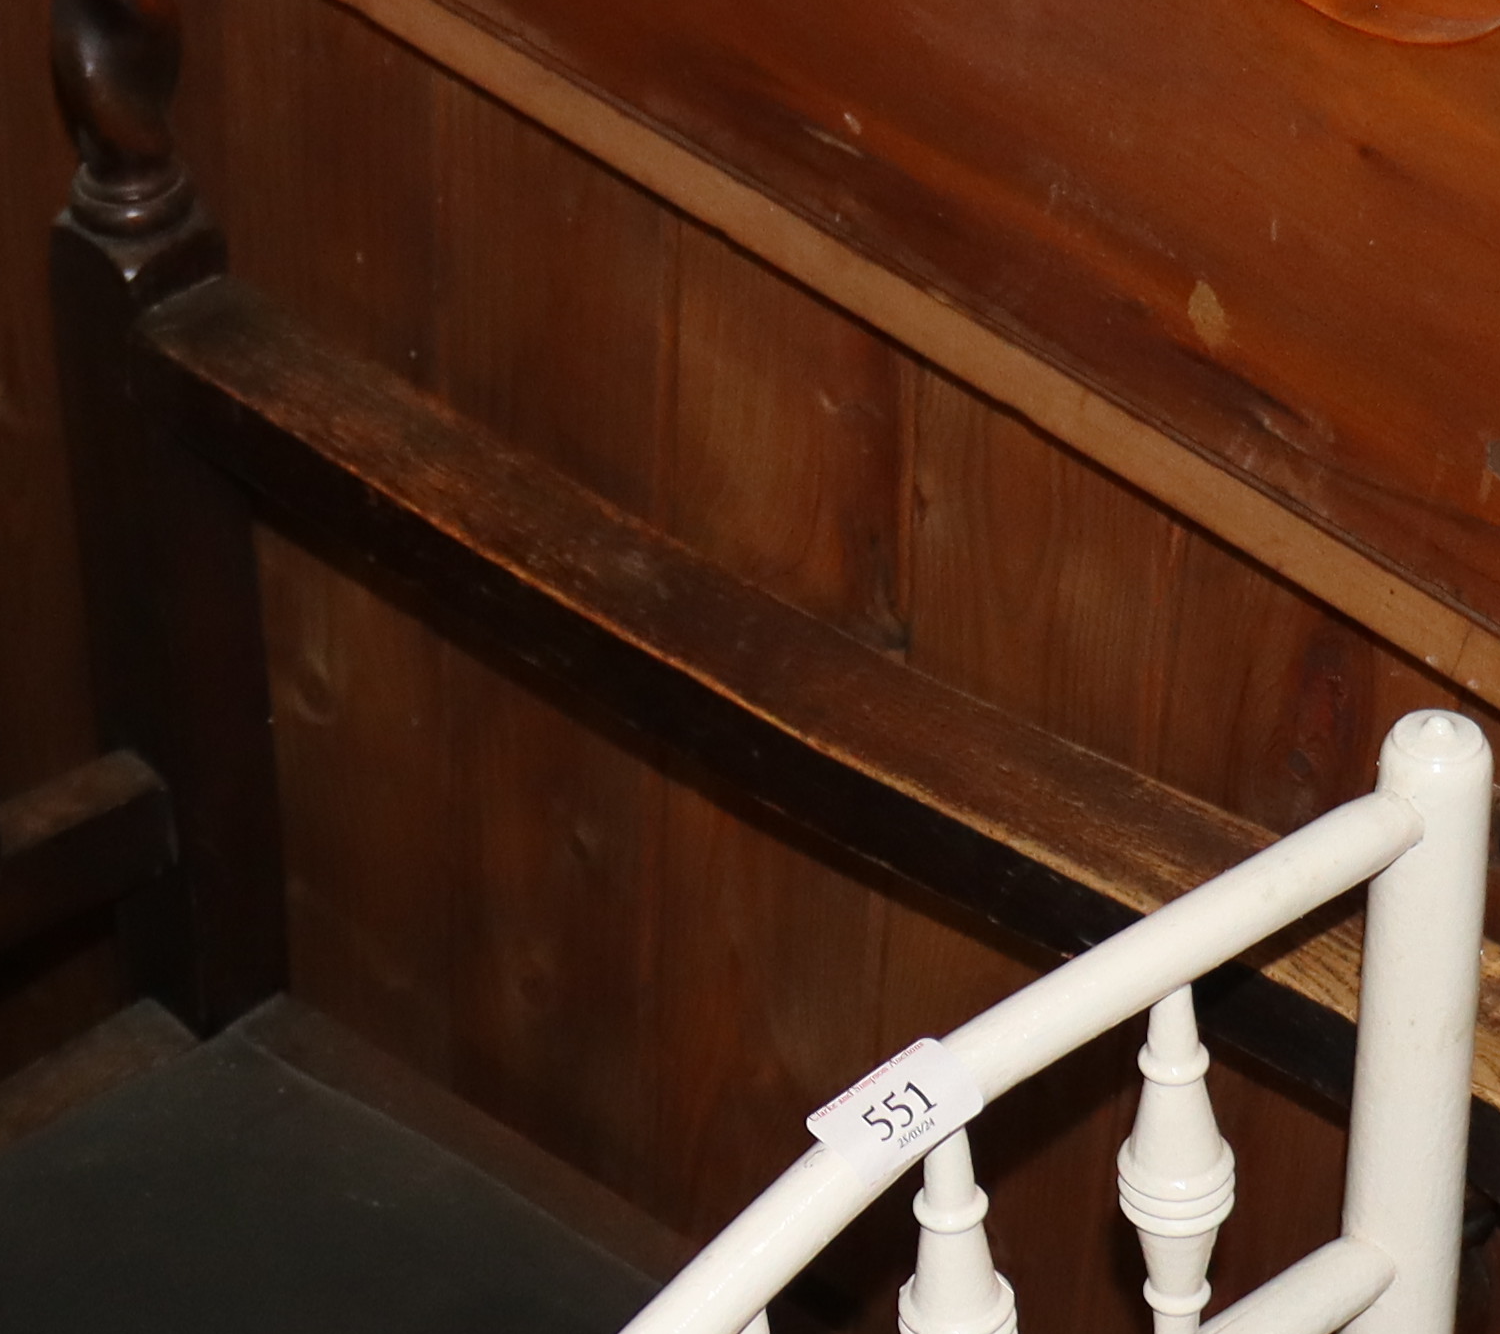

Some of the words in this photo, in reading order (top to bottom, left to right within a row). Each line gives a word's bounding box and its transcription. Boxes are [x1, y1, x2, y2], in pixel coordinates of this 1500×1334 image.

[809, 1104, 837, 1122] Clarke
[861, 1081, 937, 1142] 551
[897, 1117, 936, 1149] 25/03/24
